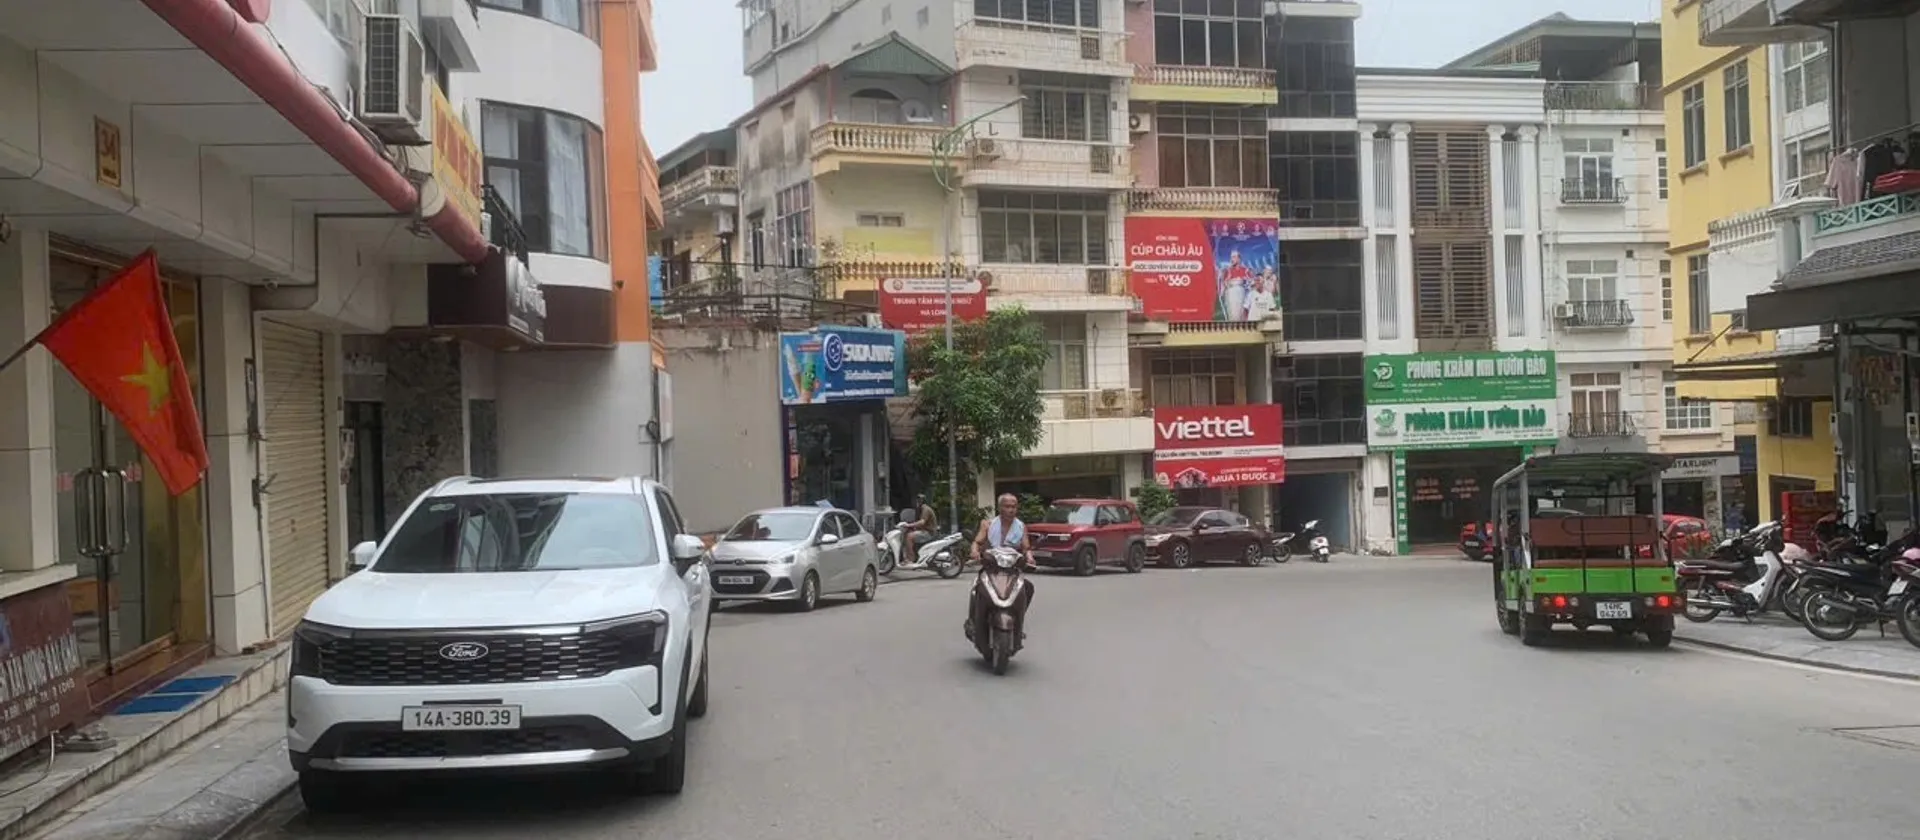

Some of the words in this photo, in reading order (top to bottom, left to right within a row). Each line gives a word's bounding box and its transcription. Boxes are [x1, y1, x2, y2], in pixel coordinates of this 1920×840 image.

[1131, 243, 1153, 256] CÚP
[1407, 357, 1441, 379] PHÒNG
[1157, 415, 1254, 440] viettel
[1212, 474, 1235, 483] MUA
[448, 644, 479, 657] Ford
[415, 709, 511, 727] 14A-380.39
